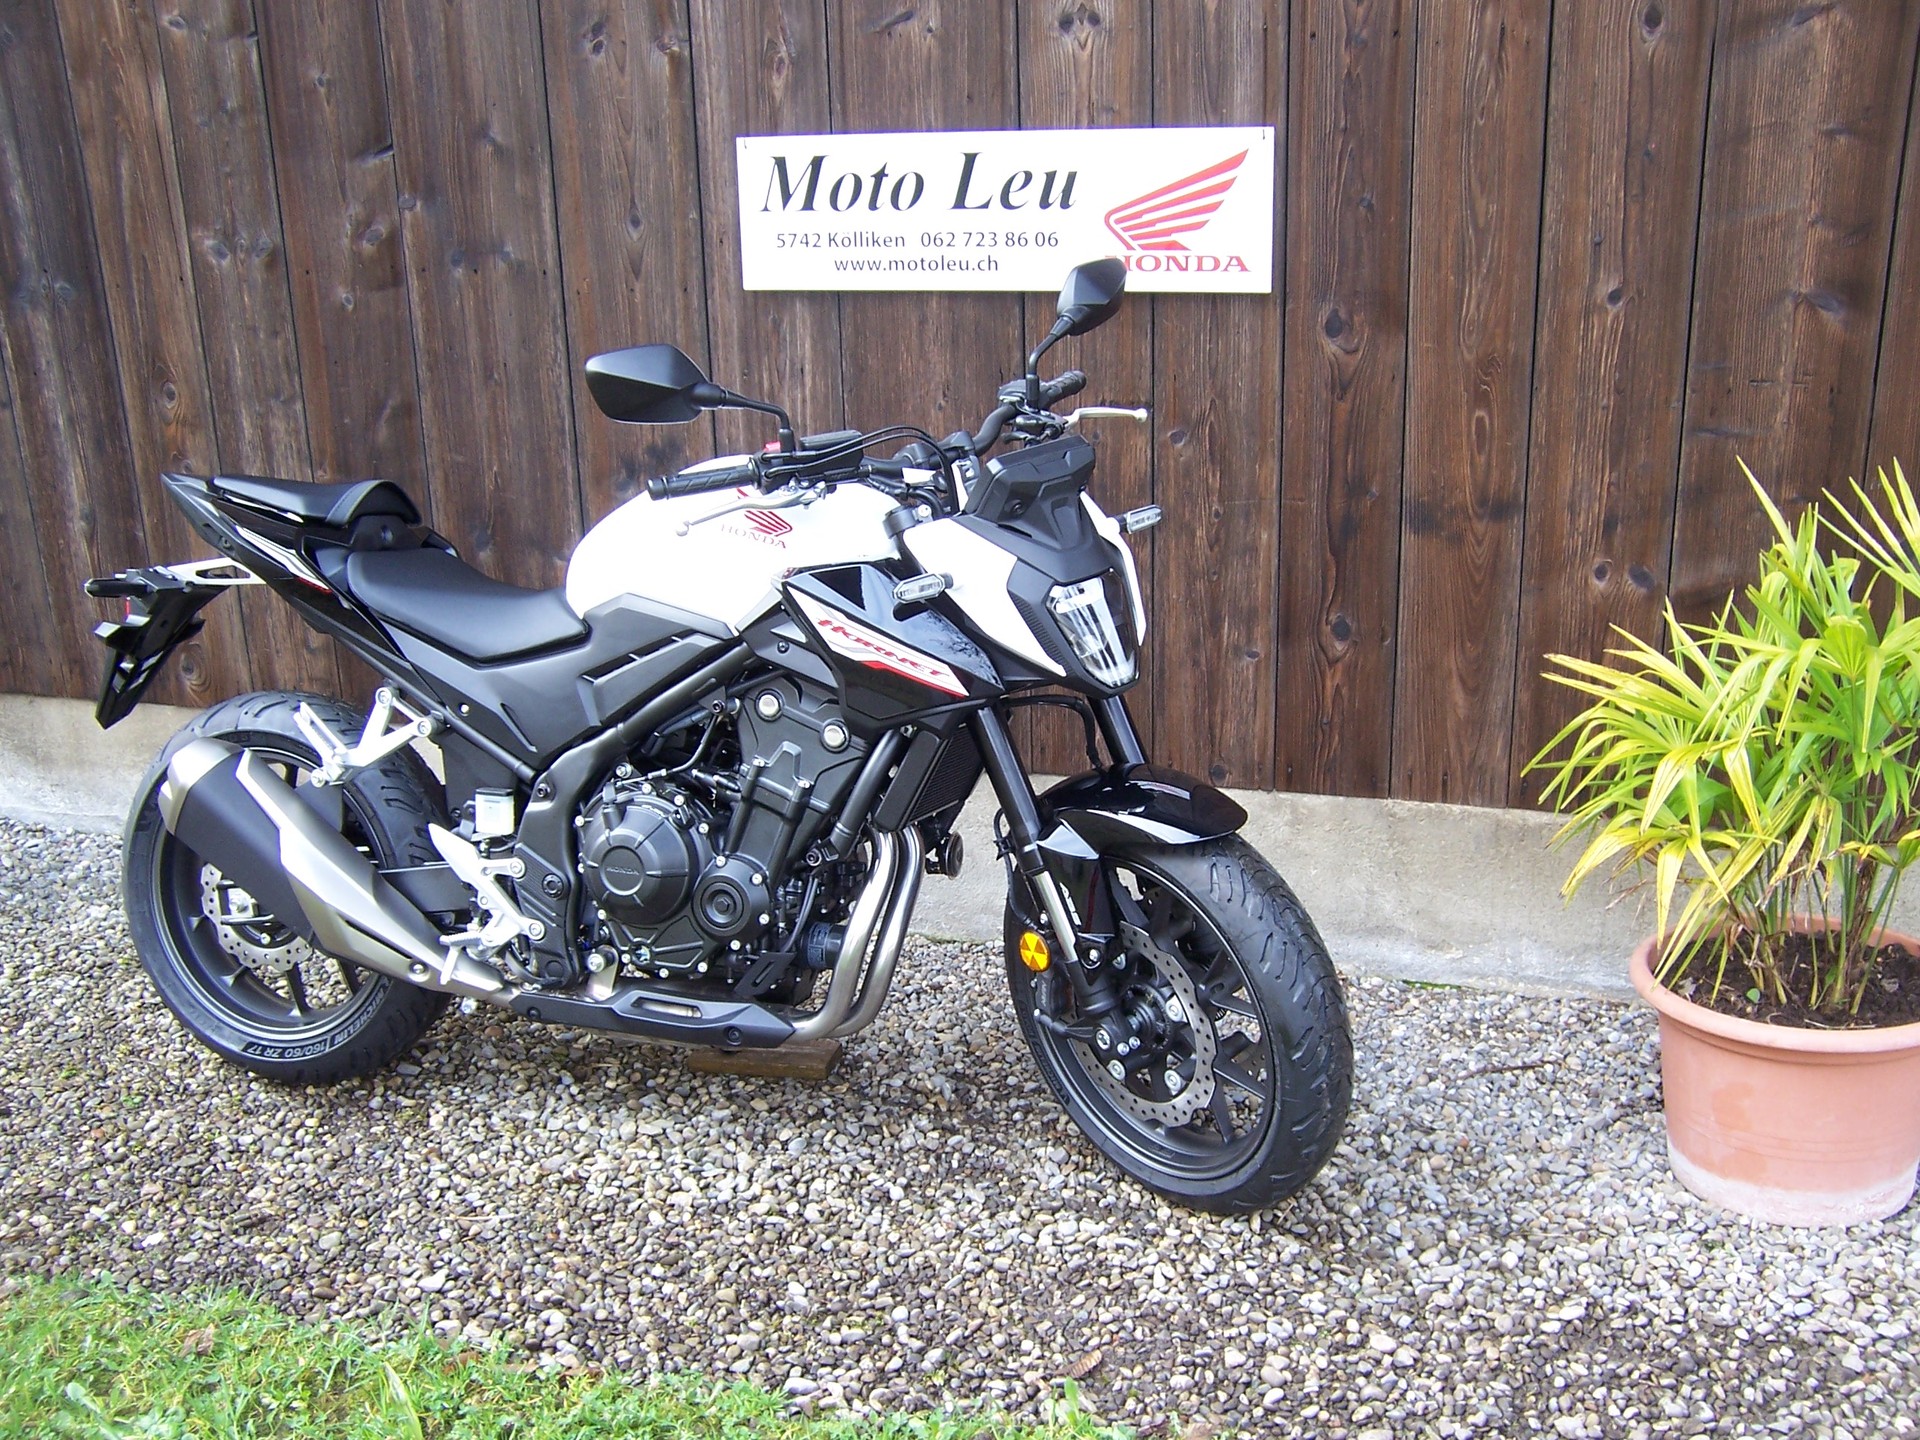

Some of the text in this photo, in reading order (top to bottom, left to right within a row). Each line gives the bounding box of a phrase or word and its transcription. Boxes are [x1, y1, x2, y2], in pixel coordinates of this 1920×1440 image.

[761, 152, 1078, 211] Moto Leu
[777, 231, 1059, 248] 5742 Kölliken 062 723 86 06
[834, 255, 998, 271] www.motoleu.ch
[248, 1044, 263, 1054] 17
[264, 1047, 283, 1058] ZR
